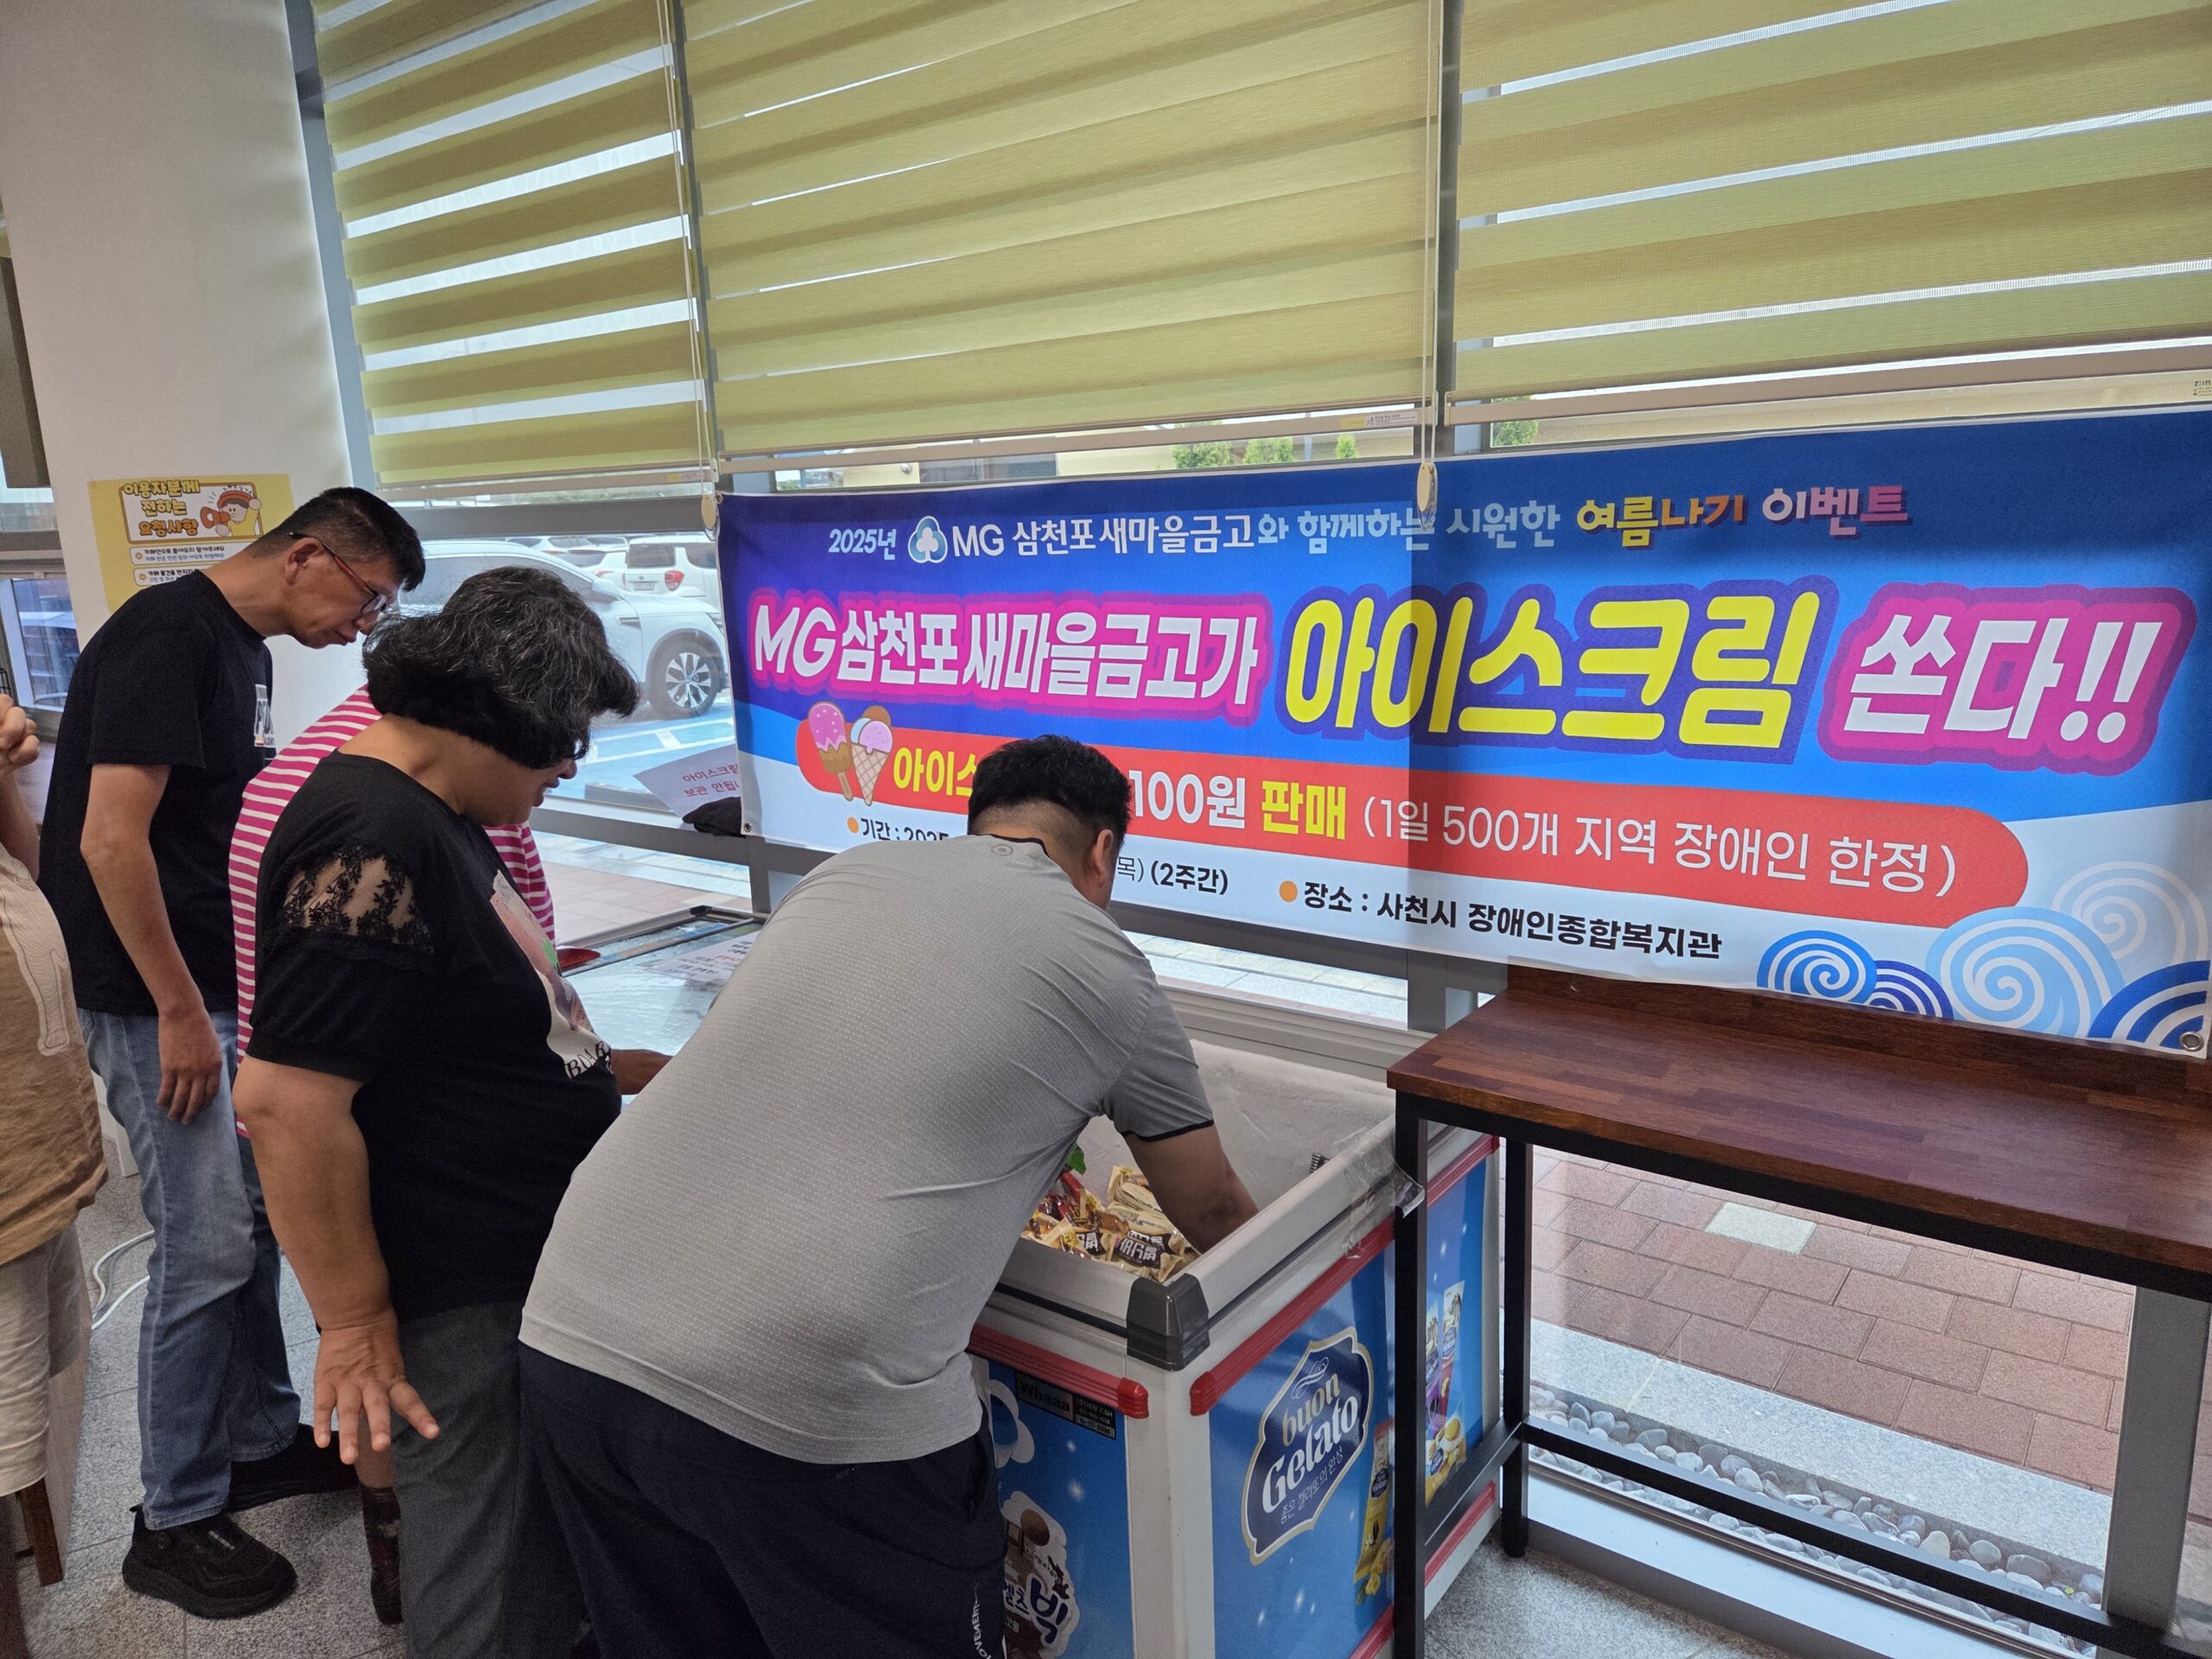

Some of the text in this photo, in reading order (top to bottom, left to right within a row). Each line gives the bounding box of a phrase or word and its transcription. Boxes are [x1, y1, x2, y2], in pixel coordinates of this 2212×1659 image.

[123, 480, 200, 497] 이용자분께
[141, 499, 188, 517] 전하는
[829, 486, 1910, 561] 2025년 MG 삼천포 새마을금고와 함께하는 시원한 여름나기 이벤트
[138, 518, 200, 537] 요청사항
[1285, 591, 1819, 748] 아이스크림
[1843, 613, 2162, 743] 쏜다!!
[684, 780, 740, 798] 보관 안됩
[893, 747, 976, 797] 아이스
[1128, 770, 1245, 829] 100원
[1262, 780, 1346, 840] 판매
[1363, 796, 1428, 842] (1일
[1443, 806, 1558, 855] 500개
[1576, 816, 1656, 862] 지역
[1675, 821, 1808, 881] 장애인
[1117, 856, 1144, 882] 목)
[1151, 861, 1229, 895] (2주간)
[1304, 881, 1352, 912] 장소
[1377, 893, 1457, 928] 사천시
[1469, 903, 1723, 959] 장애인종합복지관
[1282, 1372, 1340, 1446] buon
[1262, 1395, 1357, 1513] Gelato
